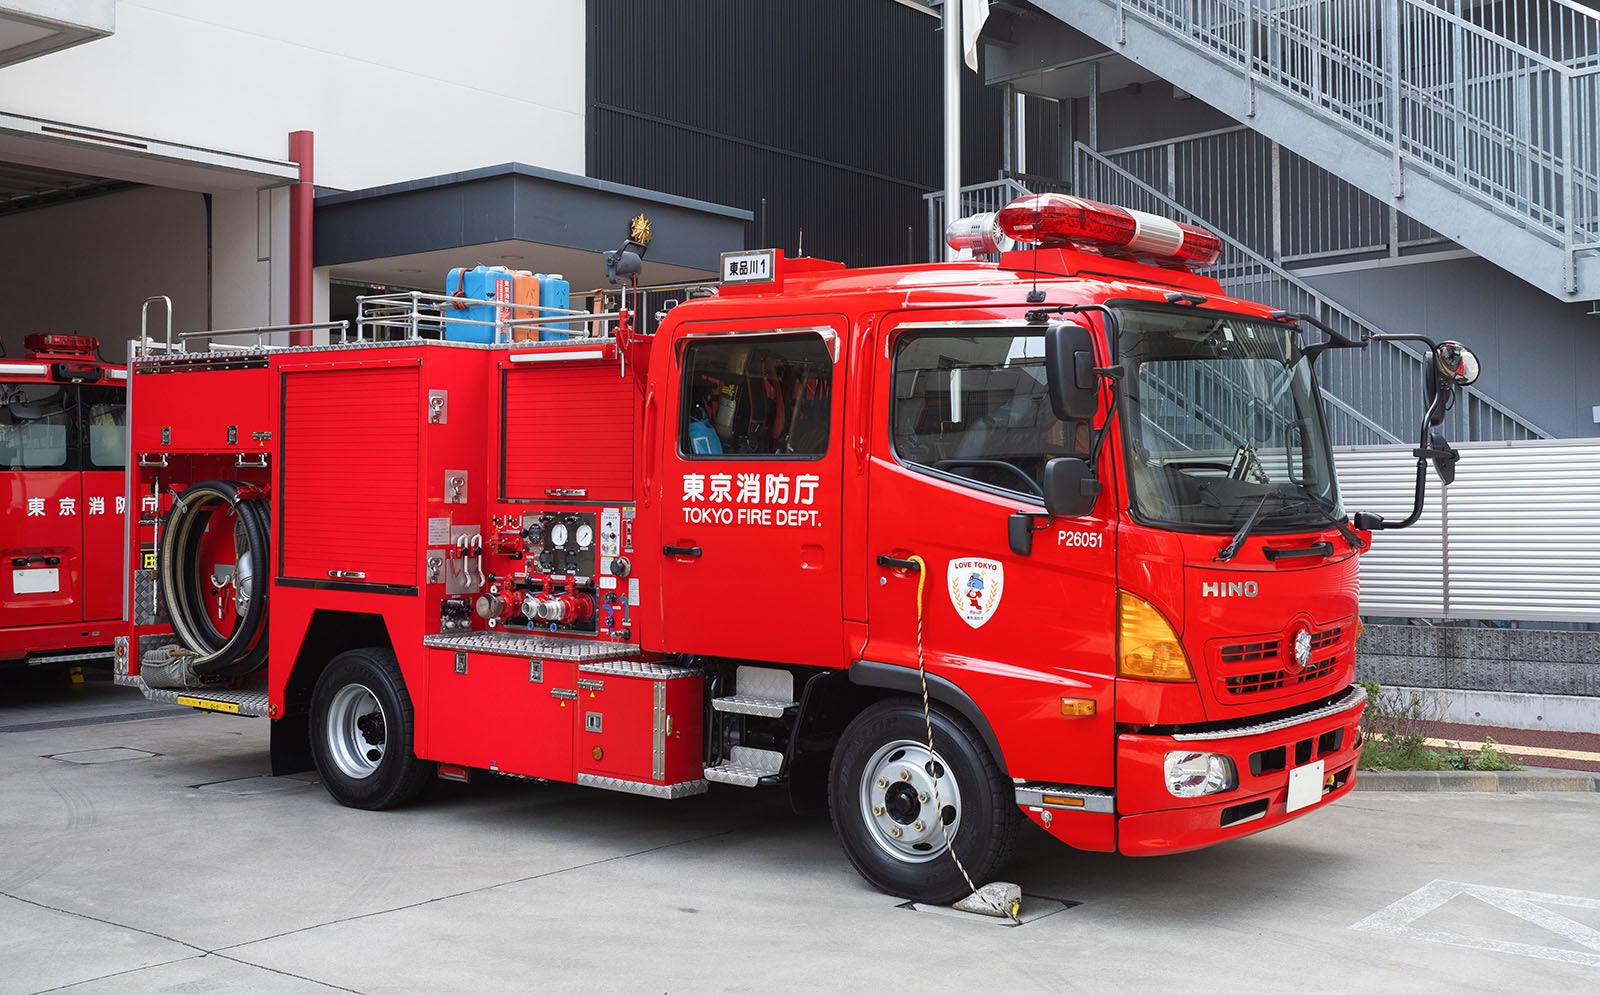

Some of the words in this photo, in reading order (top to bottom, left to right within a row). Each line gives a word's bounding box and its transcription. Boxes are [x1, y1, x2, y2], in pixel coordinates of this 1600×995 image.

[729, 259, 766, 276] 東品川1
[682, 472, 820, 505] 東京消防庁
[682, 507, 734, 524] TOKYO
[737, 508, 772, 526] FIRE
[776, 510, 822, 527] DEPT.
[1057, 530, 1103, 548] P26051
[954, 561, 972, 569] LOVE
[974, 561, 998, 571] TOKYO
[1202, 580, 1259, 597] HINO
